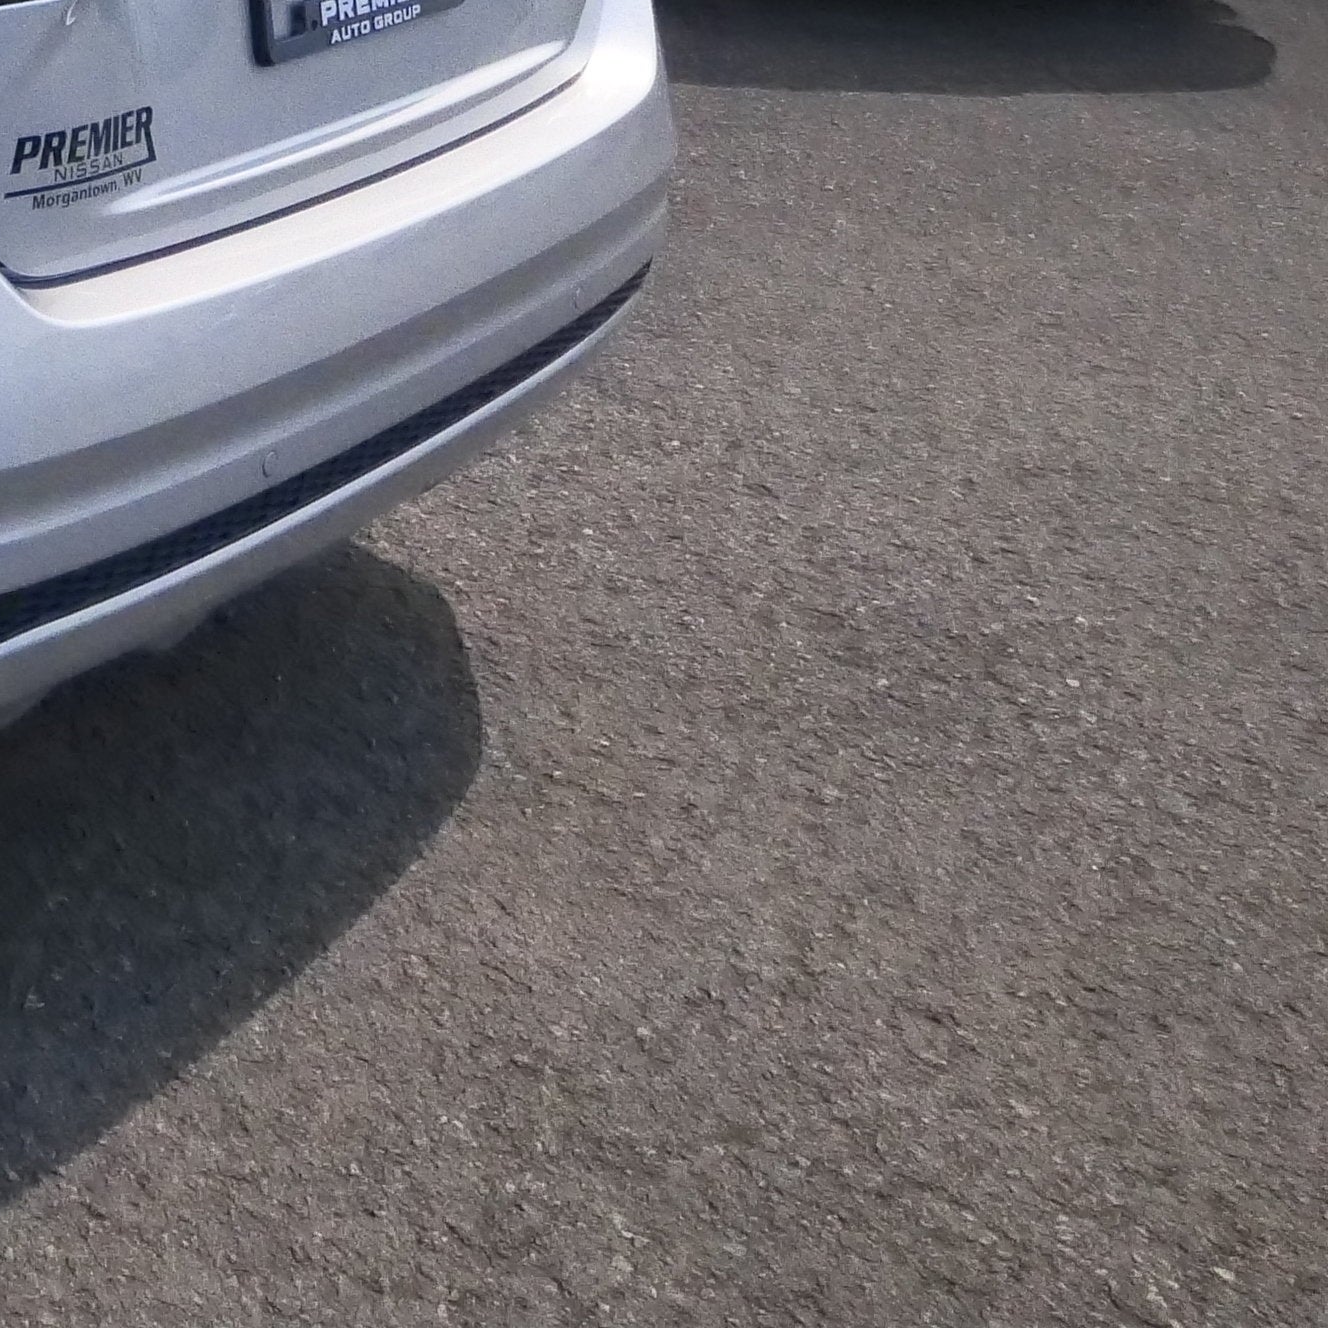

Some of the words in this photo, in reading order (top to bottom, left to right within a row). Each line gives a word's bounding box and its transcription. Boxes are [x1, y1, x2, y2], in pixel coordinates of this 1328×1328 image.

[330, 20, 371, 45] AUTO
[373, 4, 421, 30] GROUP
[10, 106, 157, 175] PREMIER
[54, 154, 123, 182] NISSAN
[123, 168, 142, 187] WV
